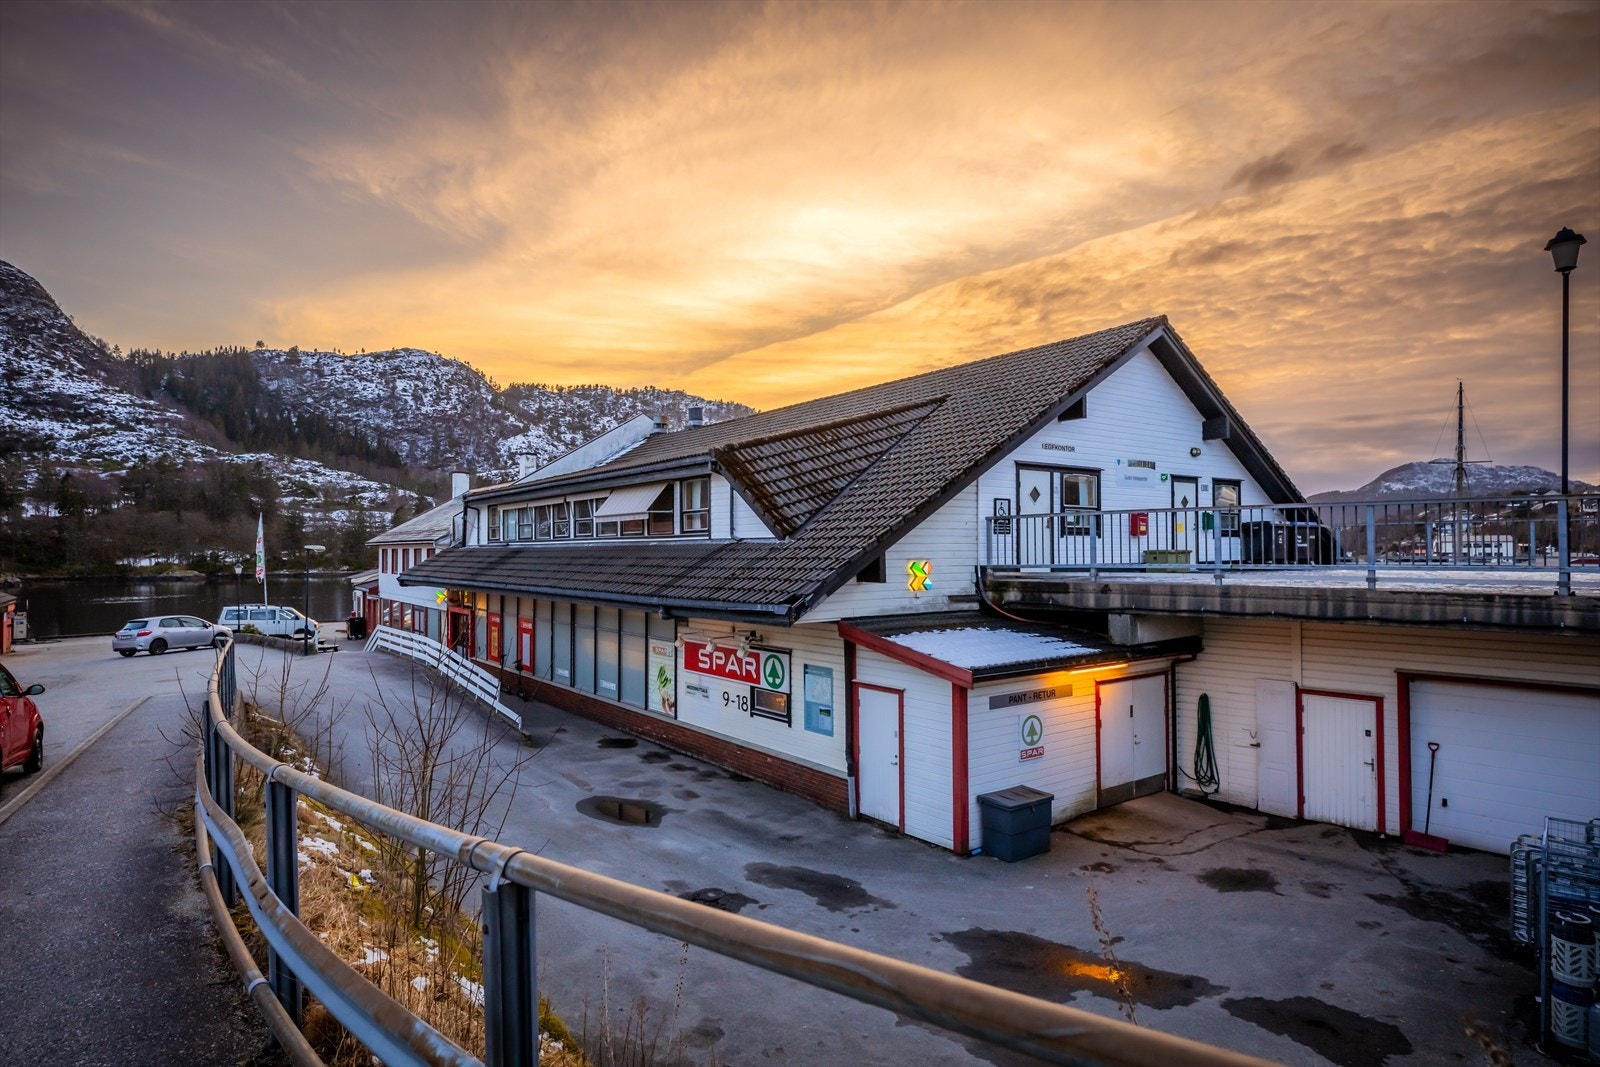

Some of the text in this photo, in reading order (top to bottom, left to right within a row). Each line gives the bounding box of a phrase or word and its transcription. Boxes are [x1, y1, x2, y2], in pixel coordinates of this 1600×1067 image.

[698, 648, 757, 679] SPAR
[722, 691, 749, 712] 9-18
[1008, 693, 1027, 704] PANT
[1033, 689, 1056, 700] RETUR
[1021, 747, 1044, 759] SPAR
